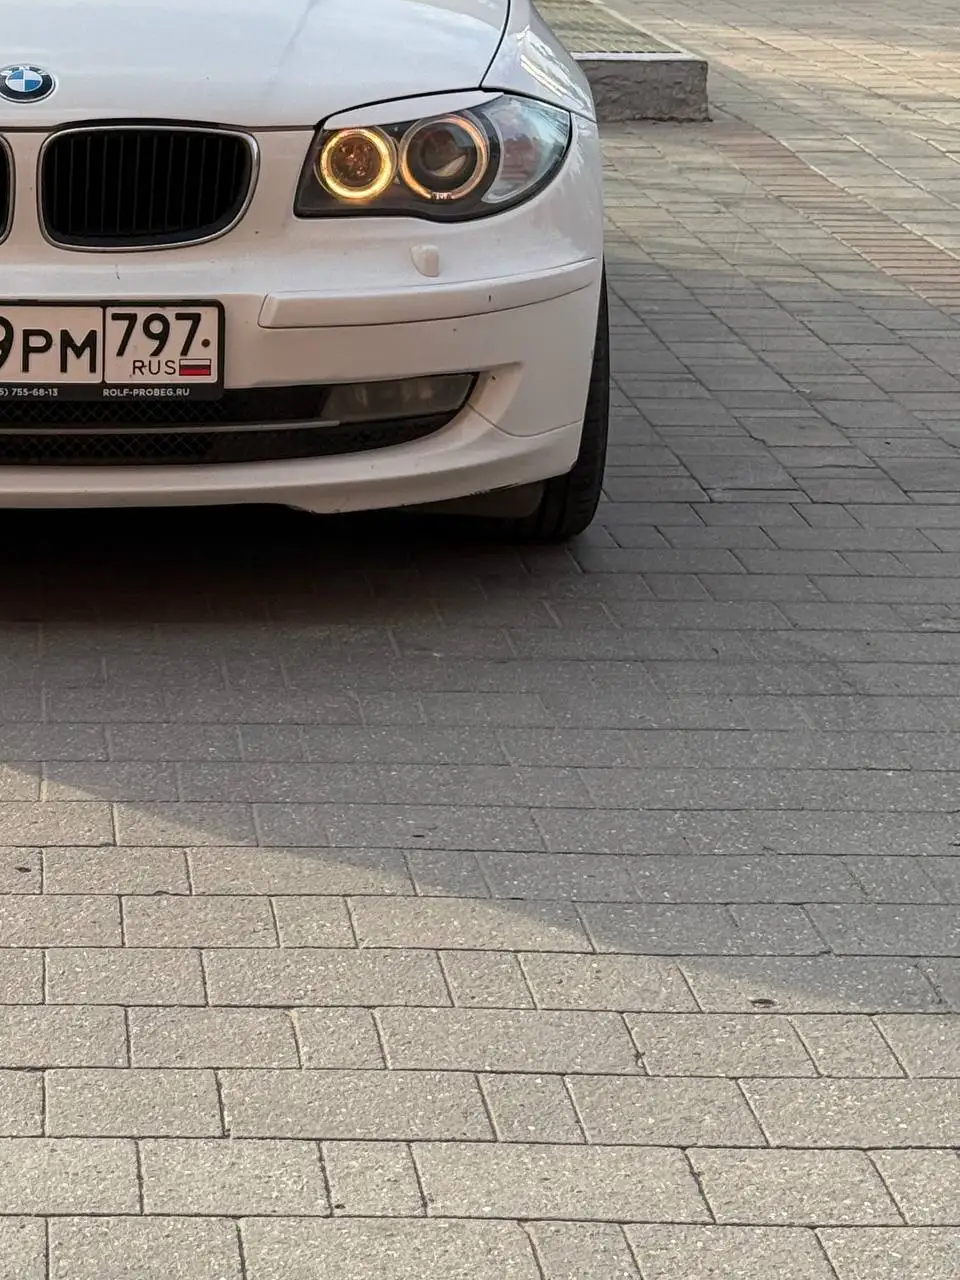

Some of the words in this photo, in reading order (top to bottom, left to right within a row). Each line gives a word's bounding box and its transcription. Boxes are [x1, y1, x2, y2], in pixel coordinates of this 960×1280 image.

[111, 313, 202, 357] 797
[132, 360, 176, 376] RUS
[11, 388, 58, 397] 755-68-13
[103, 388, 190, 397] ROLF-PROBEG.RU
